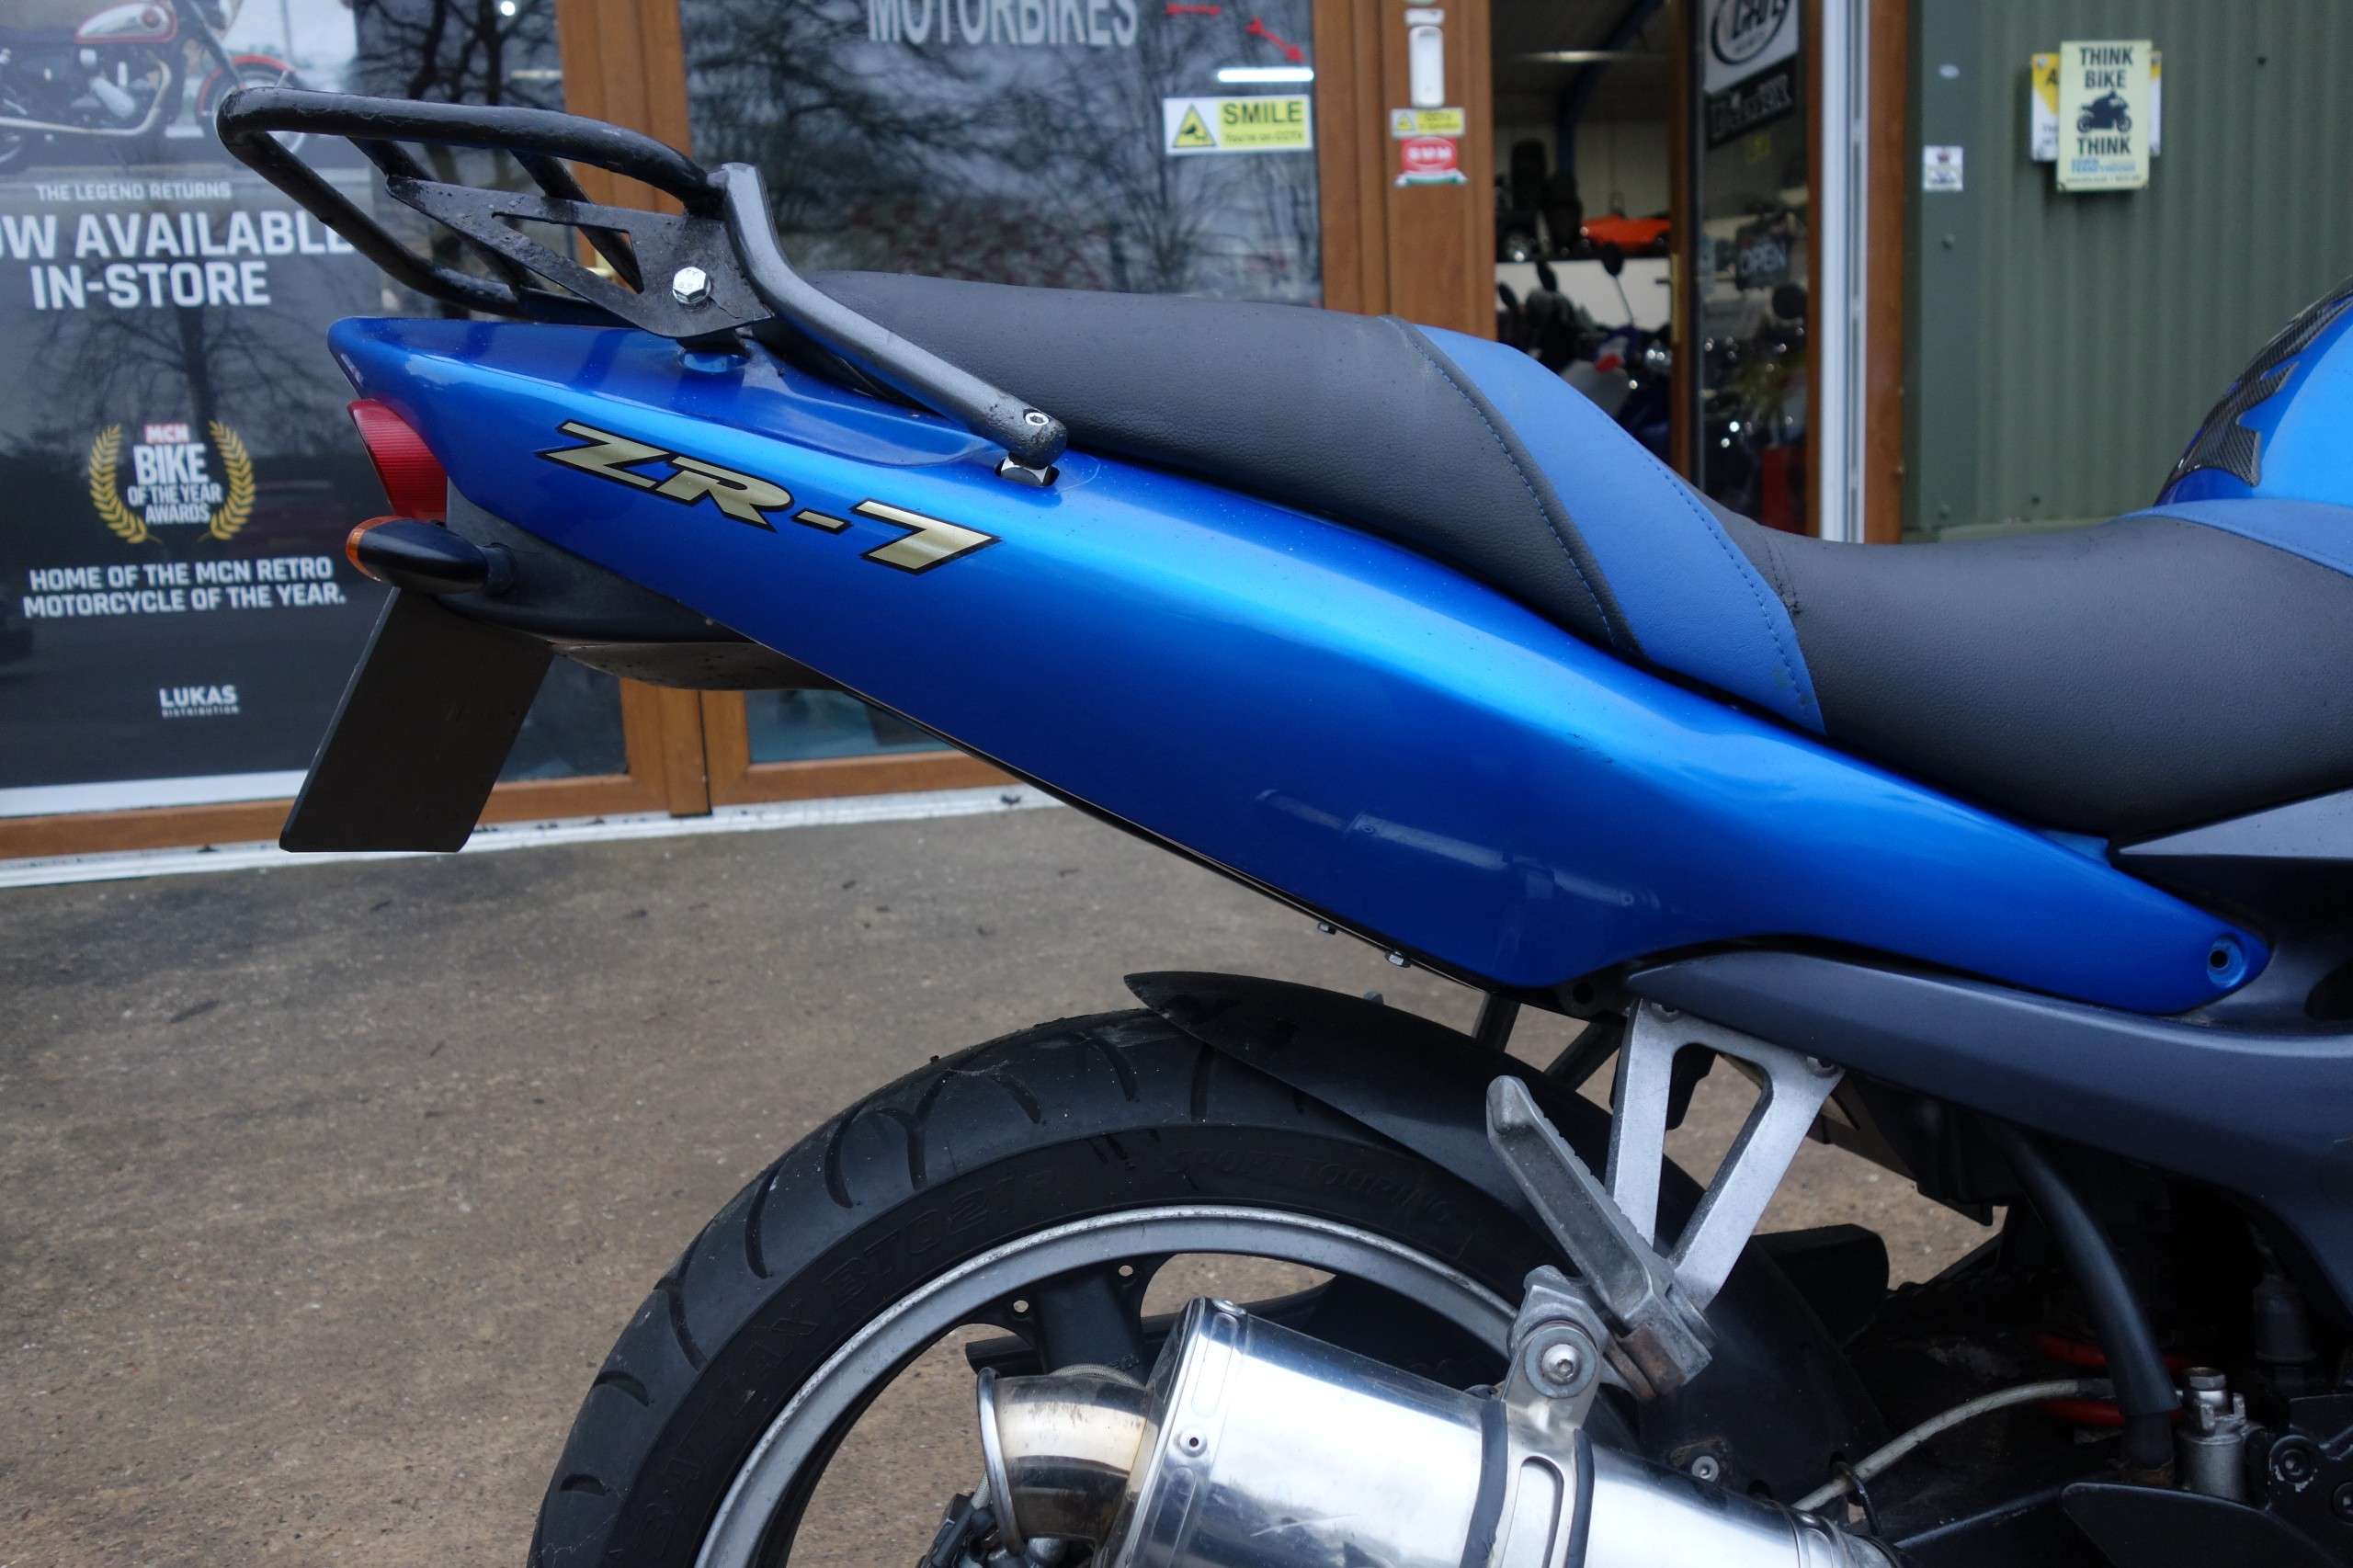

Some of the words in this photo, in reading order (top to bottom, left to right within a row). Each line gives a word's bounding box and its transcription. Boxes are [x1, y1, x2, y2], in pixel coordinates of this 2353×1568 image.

[2078, 47, 2133, 66] THINK
[2085, 70, 2126, 89] BIKE
[1223, 101, 1303, 125] SMILE
[2077, 136, 2131, 154] THINK
[35, 184, 69, 201] THE
[74, 183, 144, 200] LEGEND
[149, 182, 233, 199] RETURNS
[30, 261, 271, 310] IN-STORE
[145, 425, 189, 443] MCN
[132, 442, 210, 486] BIKE
[127, 485, 147, 506] OF
[150, 483, 179, 506] THE
[179, 483, 223, 504] YEAR
[535, 419, 1002, 574] ZR-7
[144, 503, 211, 525] AWARDS
[29, 567, 104, 592] HOME
[108, 565, 139, 589] OF
[142, 562, 189, 586] THE
[195, 560, 251, 585] MCN
[256, 556, 334, 582] RETRO
[23, 591, 185, 619] MOTORCYCLE
[189, 587, 222, 611] OF
[226, 585, 273, 608] THE
[278, 581, 347, 607] YEAR.
[158, 684, 237, 708] LUKAS
